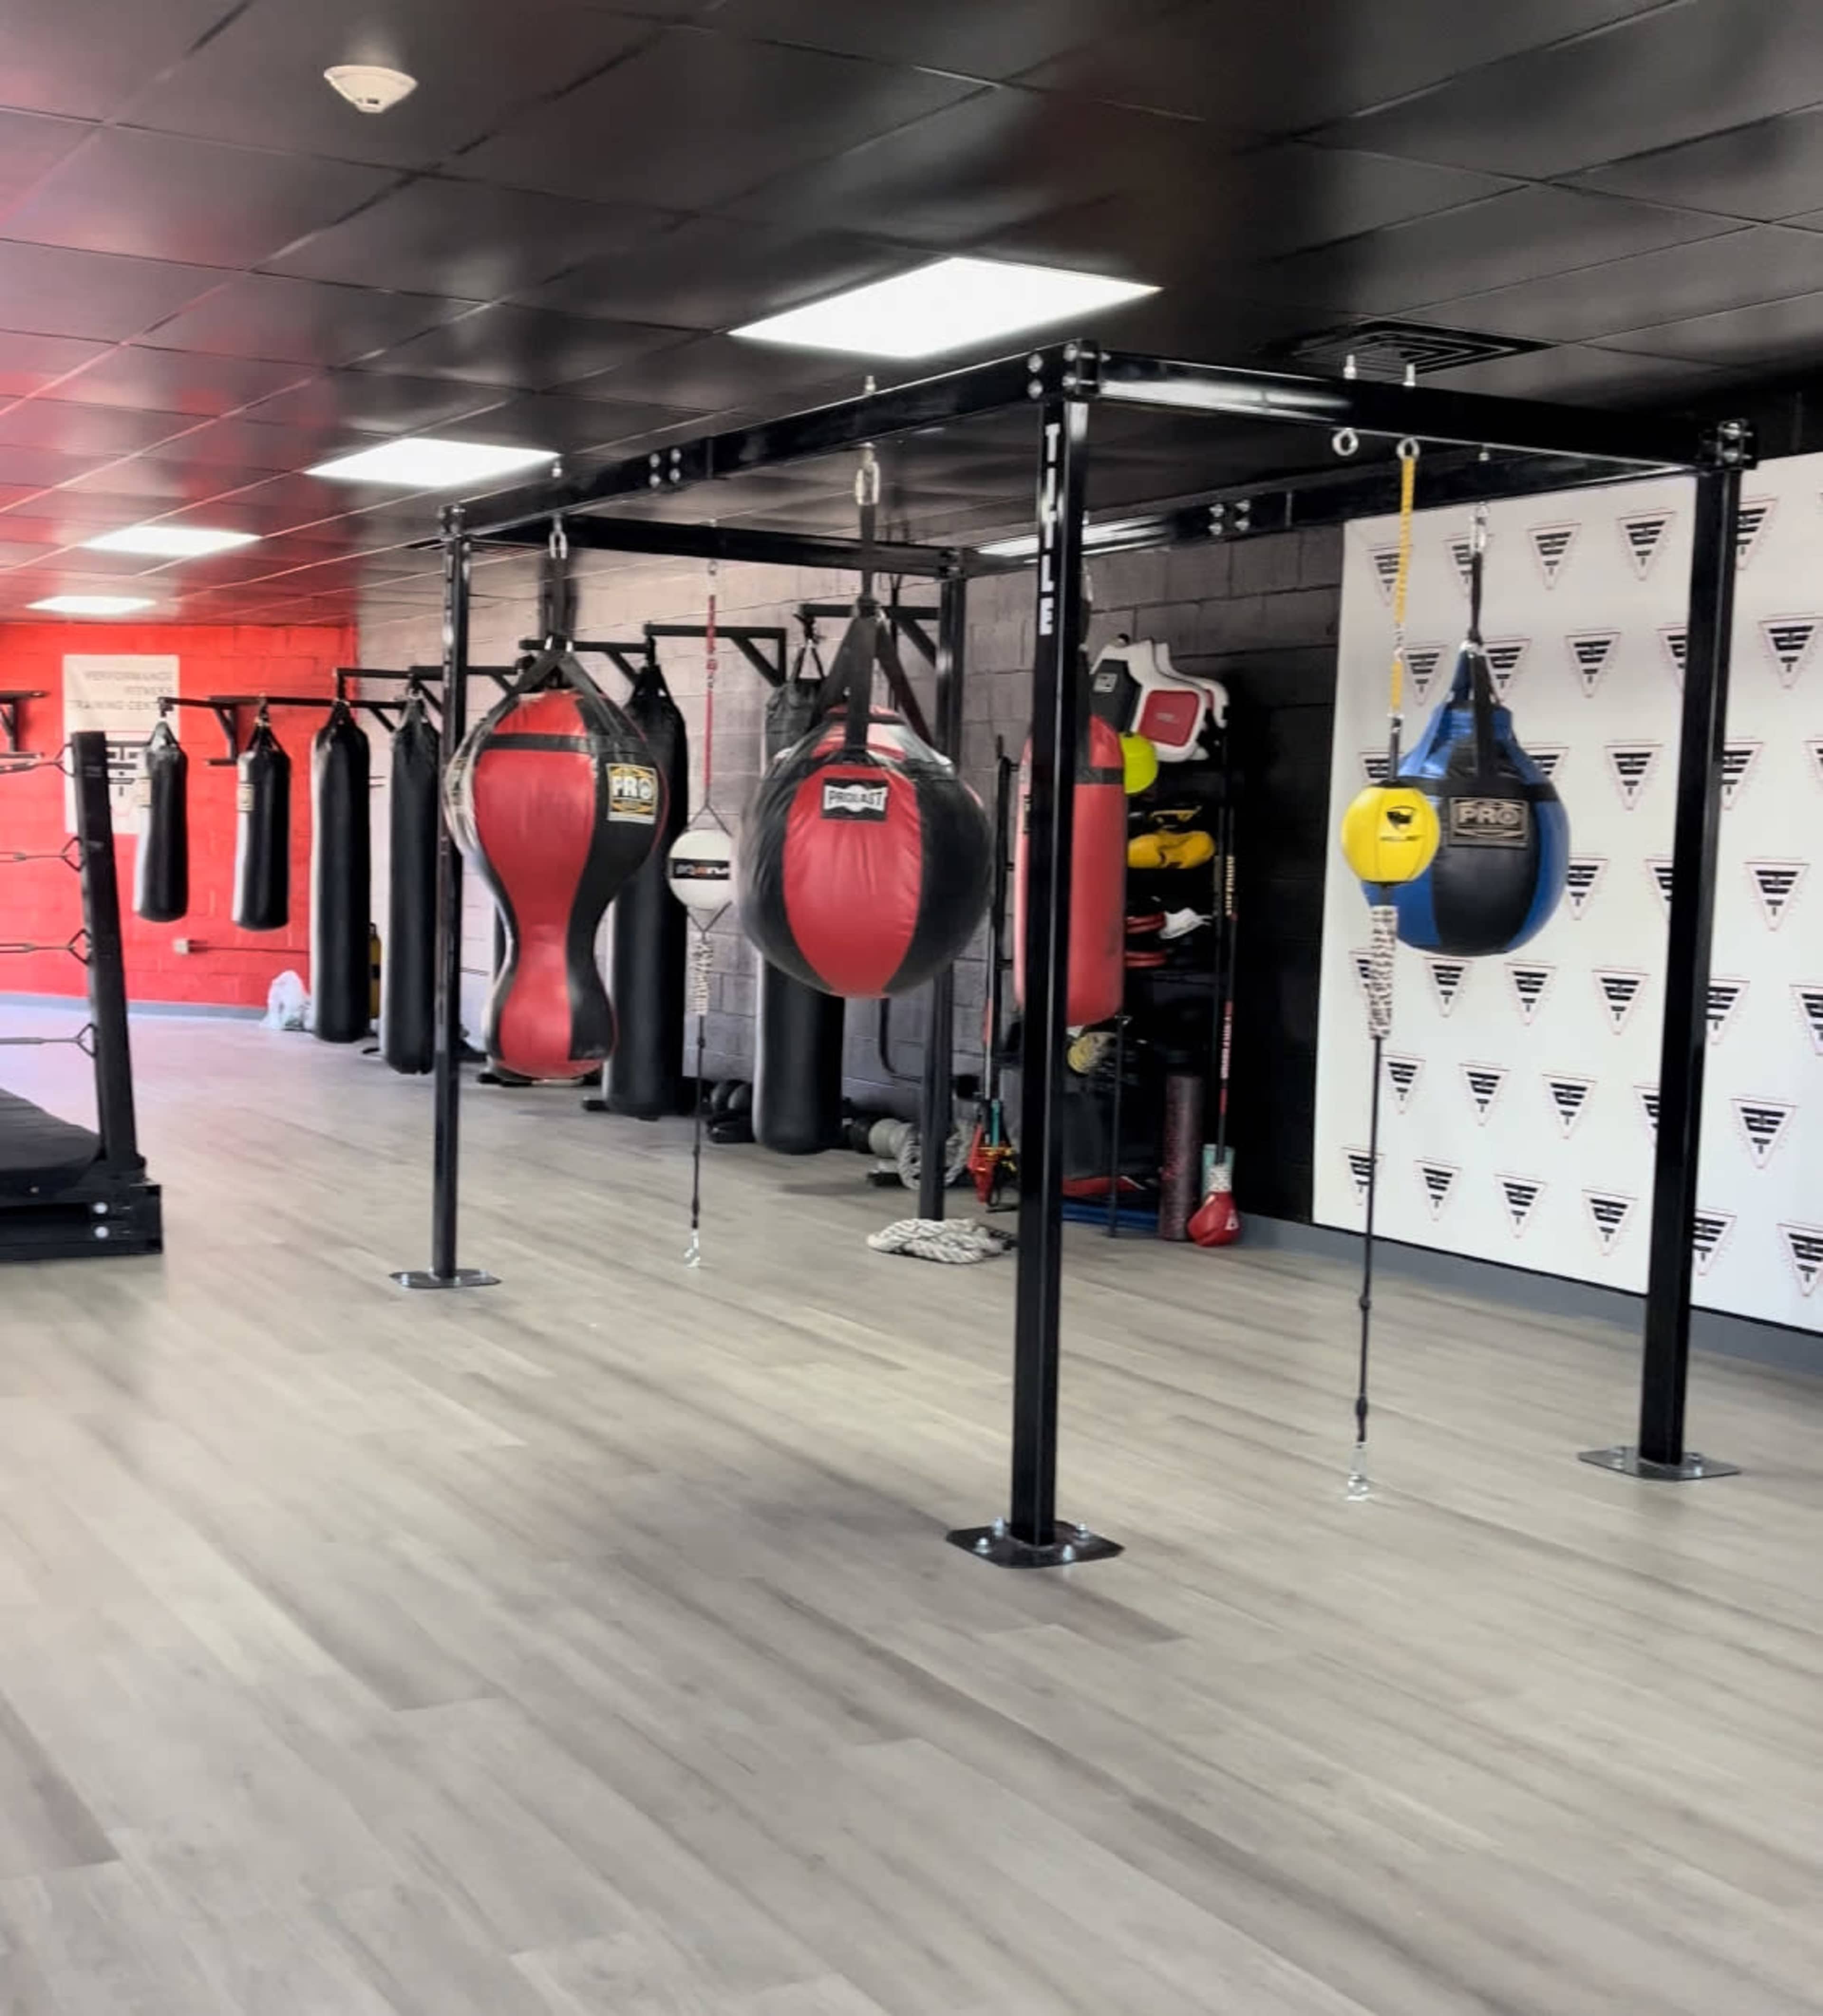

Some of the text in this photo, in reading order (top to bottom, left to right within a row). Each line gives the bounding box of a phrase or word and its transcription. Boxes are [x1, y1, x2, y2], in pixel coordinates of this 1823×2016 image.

[1040, 423, 1061, 635] TITLE
[611, 775, 652, 800] PRO
[1458, 806, 1519, 825] PRO
